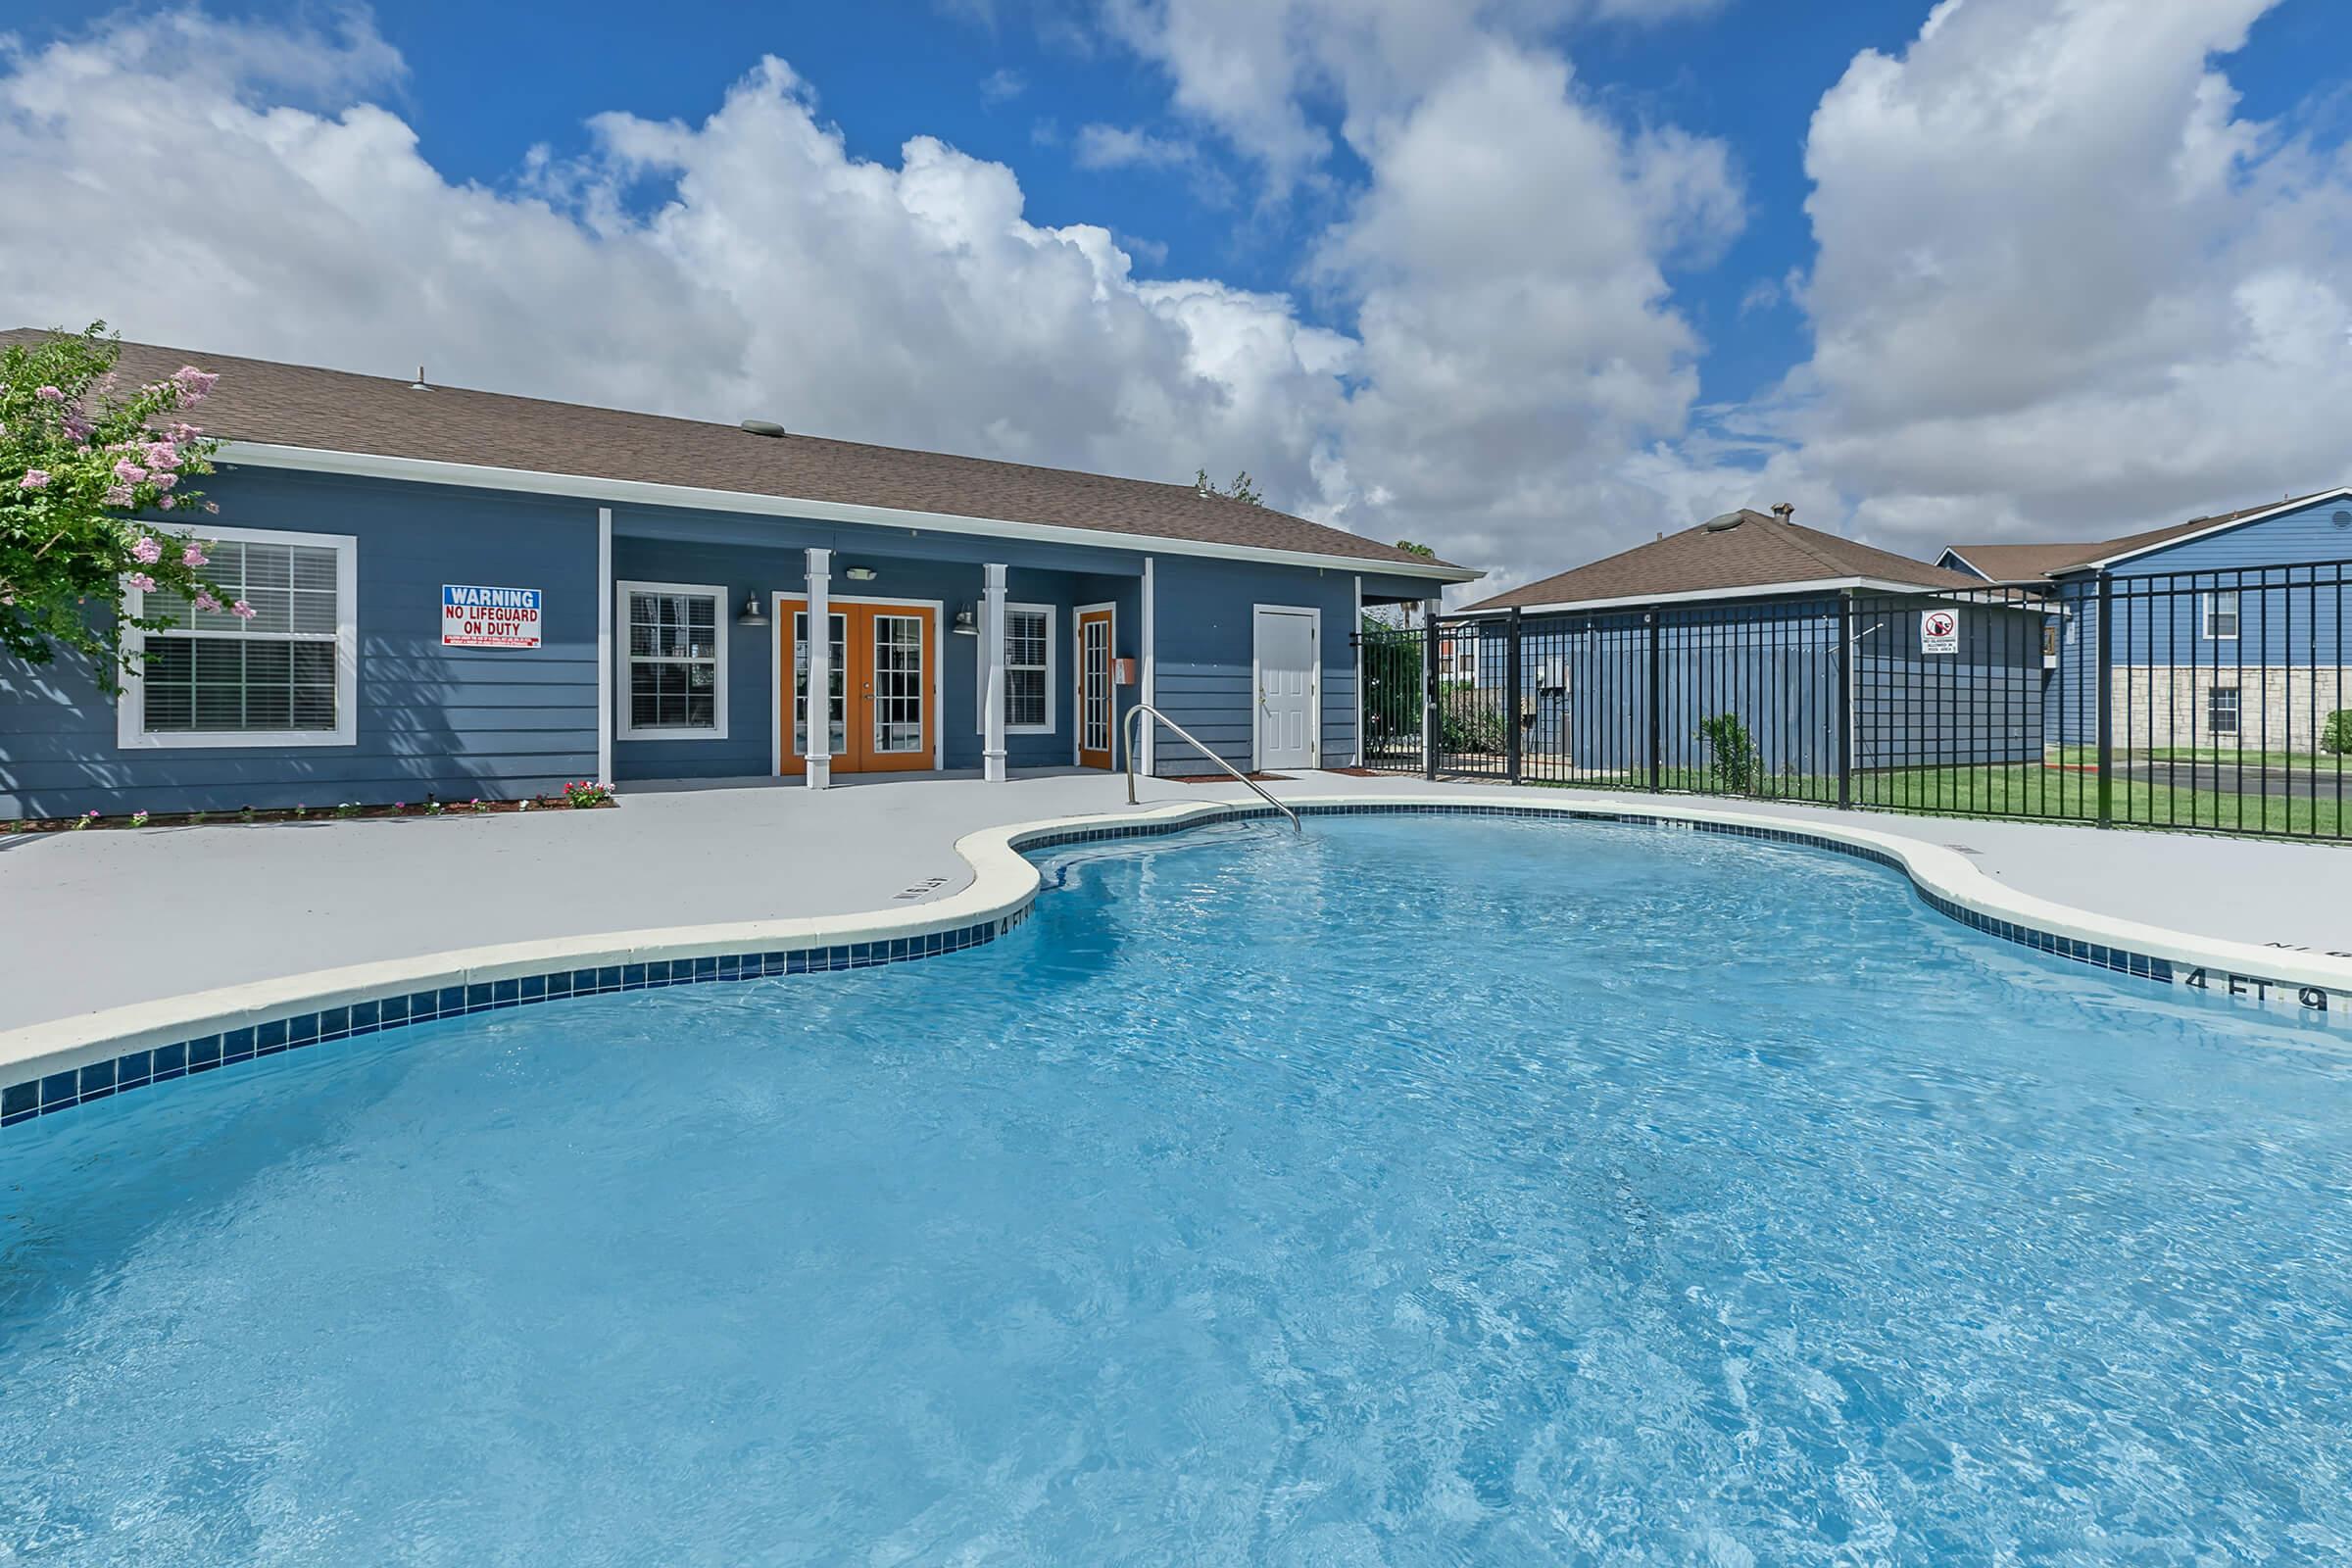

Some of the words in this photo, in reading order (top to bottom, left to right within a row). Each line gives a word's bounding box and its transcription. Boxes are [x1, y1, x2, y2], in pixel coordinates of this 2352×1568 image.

[451, 588, 533, 607] WARNING
[446, 606, 464, 619] NO
[469, 607, 538, 621] LIFEGUARD
[464, 621, 481, 634] ON
[487, 622, 520, 636] DUTY
[2184, 967, 2209, 989] 4
[2229, 973, 2274, 1001] FT
